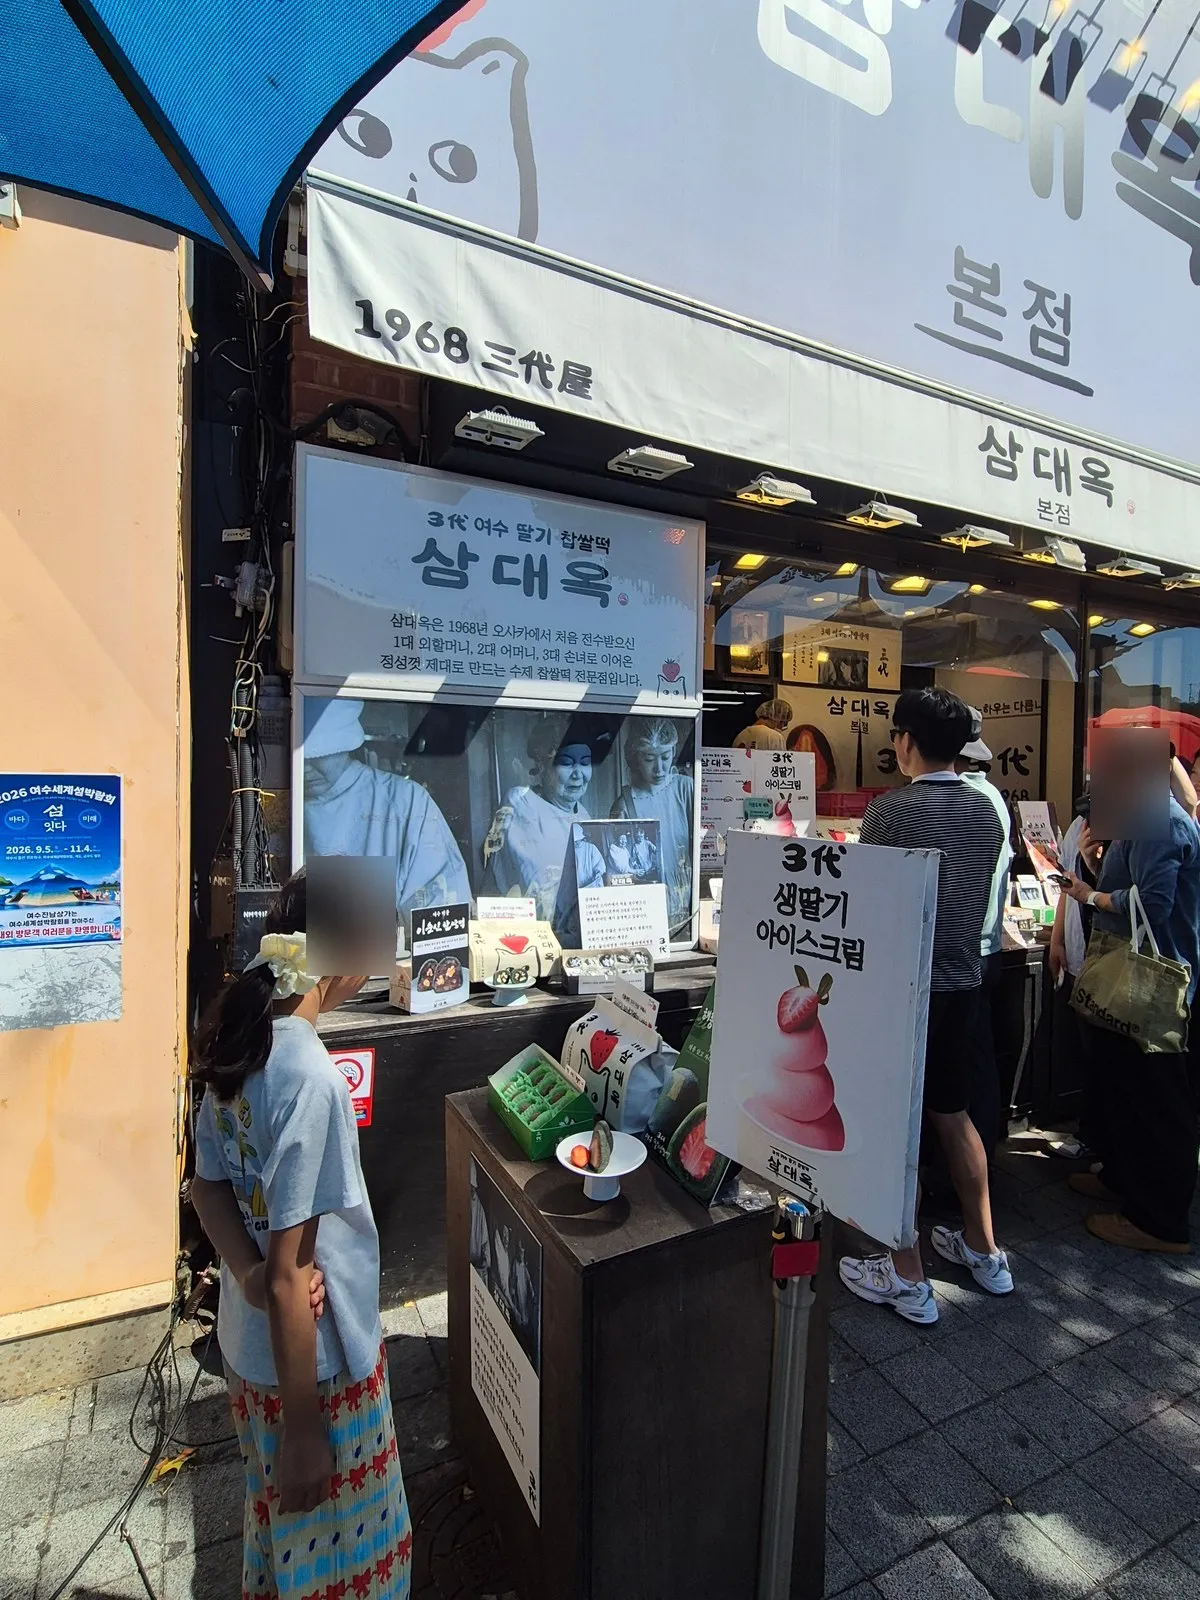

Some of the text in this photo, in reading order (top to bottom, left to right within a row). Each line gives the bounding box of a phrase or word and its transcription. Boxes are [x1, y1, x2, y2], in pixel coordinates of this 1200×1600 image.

[946, 245, 1073, 367] 본점
[354, 298, 594, 401] 1968 三代屋
[977, 424, 1114, 508] 삼대옥
[1036, 497, 1071, 526] 본점
[474, 516, 509, 537] 여수
[516, 523, 552, 545] 딸기
[560, 530, 611, 554] 찹쌀떡
[411, 536, 613, 608] 삼대옥
[390, 612, 636, 651] 삼대옥은 1968년 오사카에서 처음 전수받으신
[394, 634, 633, 669] 1대 외할머니, 2대 어머니, 3대 손녀로 이어온
[380, 653, 643, 688] 정성껏 제대로 만드는 수제 찹쌀떡 전문점입니다.
[827, 696, 890, 719] 삼대옥
[765, 779, 801, 790] 아이스크림
[771, 766, 796, 778] 생딸기
[30, 785, 116, 805] 여수세계섬박람회
[43, 804, 63, 817] 섬
[44, 820, 67, 832] 잇다
[6, 846, 34, 854] 2026.
[781, 843, 848, 879] 3代
[773, 882, 849, 929] 생딸기
[756, 919, 865, 972] 아이스크림
[768, 1156, 813, 1189] 삼대옥
